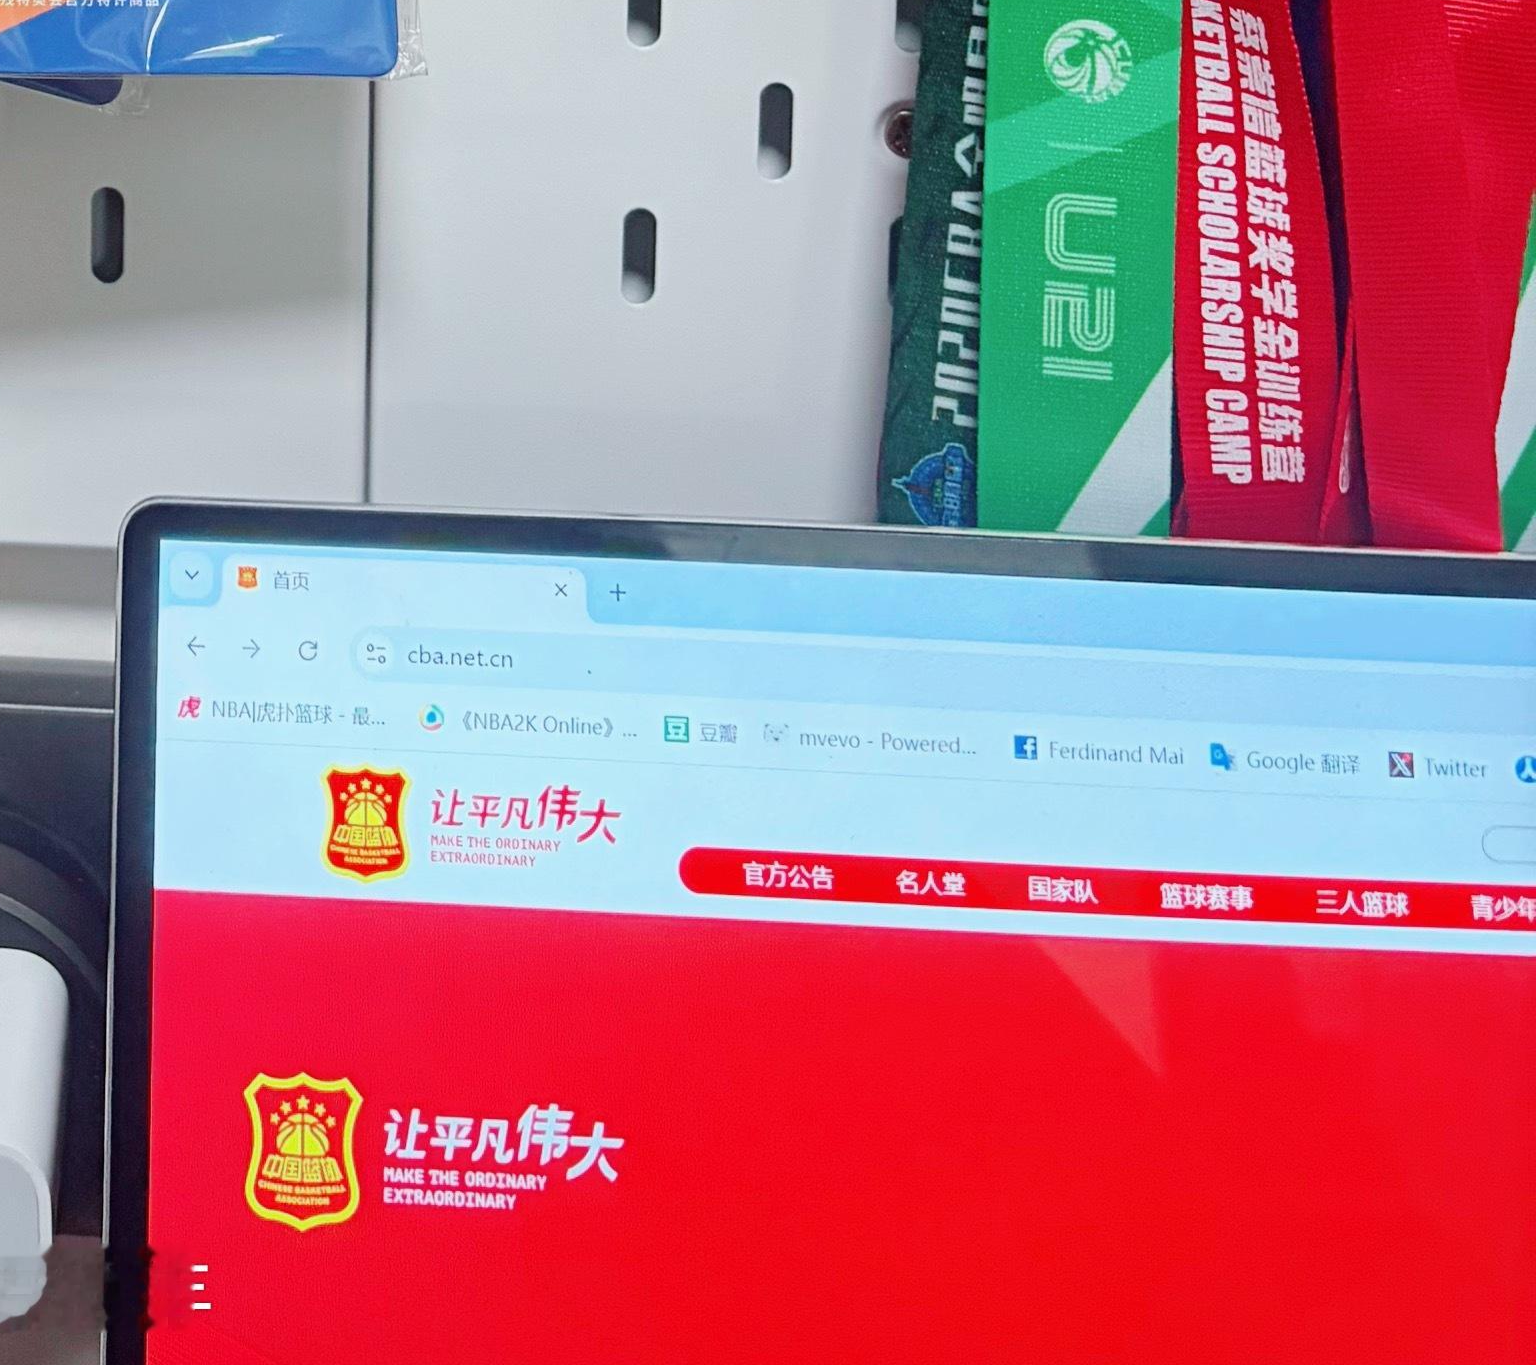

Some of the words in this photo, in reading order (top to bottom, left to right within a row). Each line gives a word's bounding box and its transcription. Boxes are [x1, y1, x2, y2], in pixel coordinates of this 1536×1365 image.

[1228, 7, 1307, 485] 蔡崇信篮球奖学金训练营
[1196, 142, 1248, 384] SCHOLARSHIP
[1042, 194, 1118, 382] U21
[1204, 389, 1253, 485] CAMP
[273, 571, 311, 591] 首页
[407, 645, 514, 669] cba.net.cn
[699, 722, 738, 744] 豆瓣
[799, 732, 861, 749] mvevo
[1049, 741, 1143, 764] Ferdinand
[1150, 746, 1185, 765] Mai
[1247, 751, 1316, 772] Google
[1321, 753, 1361, 776] 翻译
[1424, 757, 1488, 779] Twitter
[431, 784, 622, 845] 让平凡伟大
[430, 835, 464, 848] MAKE
[466, 835, 491, 849] THE
[495, 837, 561, 852] ORDINARY
[430, 850, 537, 868] EXTRAORDINARY
[742, 861, 835, 891] 官方公告
[896, 870, 967, 897] 名人堂
[1027, 876, 1100, 905] 国家队
[1160, 882, 1254, 912] 篮球赛事
[1315, 889, 1411, 918] 三人篮球
[383, 1102, 625, 1184] 让平凡伟大
[262, 1156, 343, 1184] 中国篮协
[383, 1166, 424, 1184] MAKE
[429, 1169, 460, 1187] THE
[464, 1171, 548, 1191] ORDINARY
[275, 1194, 331, 1206] ASSOCIATION
[293, 1183, 347, 1196] BASKETBALL
[383, 1186, 517, 1211] EXTRAORDINARY
